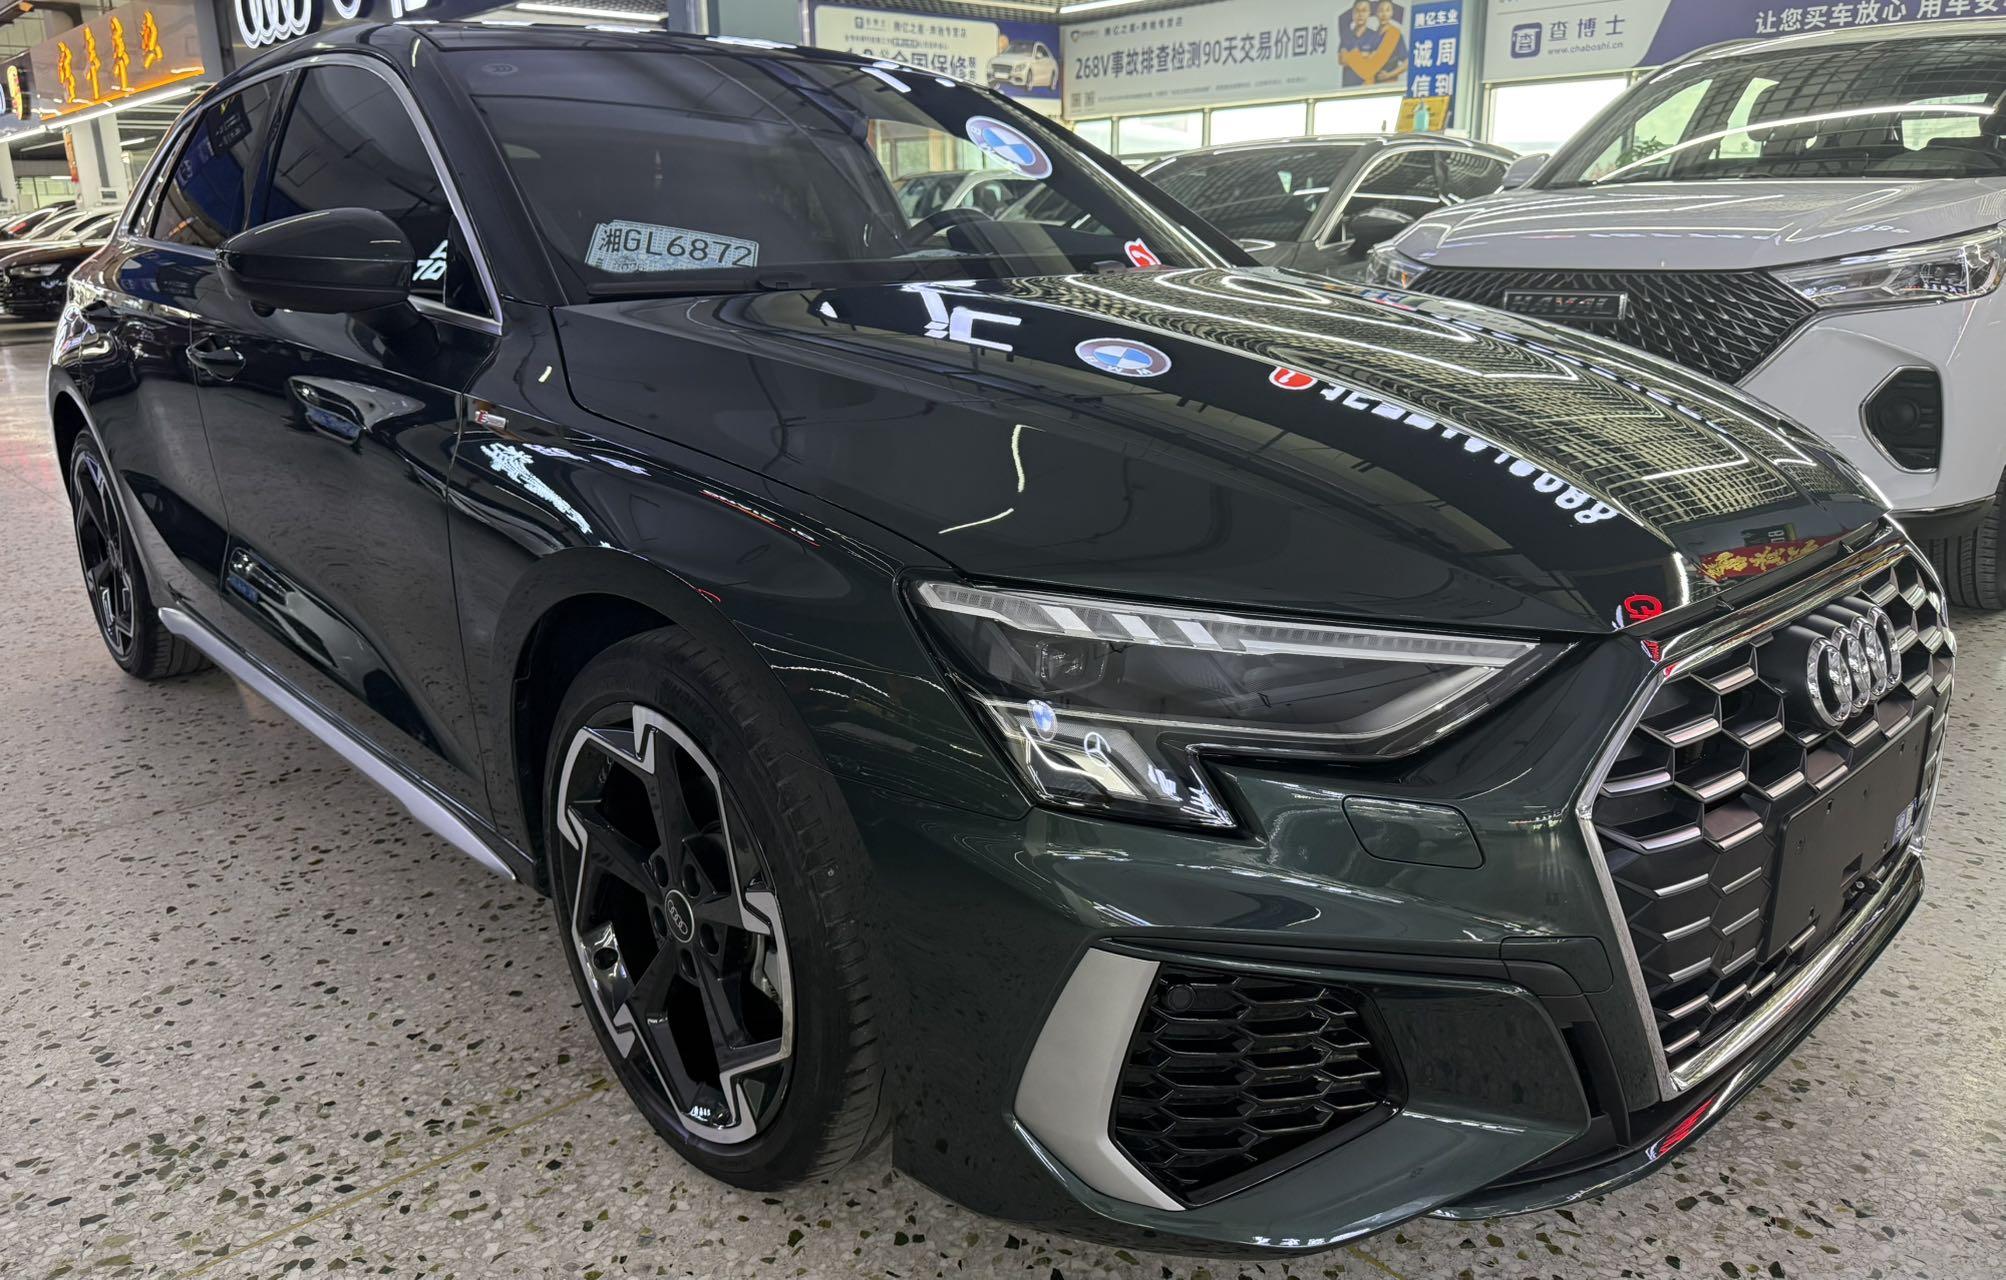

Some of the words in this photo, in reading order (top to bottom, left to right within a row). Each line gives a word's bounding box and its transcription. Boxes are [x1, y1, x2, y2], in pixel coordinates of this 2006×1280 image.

[1548, 14, 1625, 41] 查博士
[1755, 0, 1906, 34] 让您买车放心
[1916, 0, 2006, 19] 用车安
[1075, 24, 1328, 80] 268V事故排查检测90天交易价回购
[1548, 41, 1623, 55] www.chaboshi.cn
[598, 228, 752, 268] 湘GL6872
